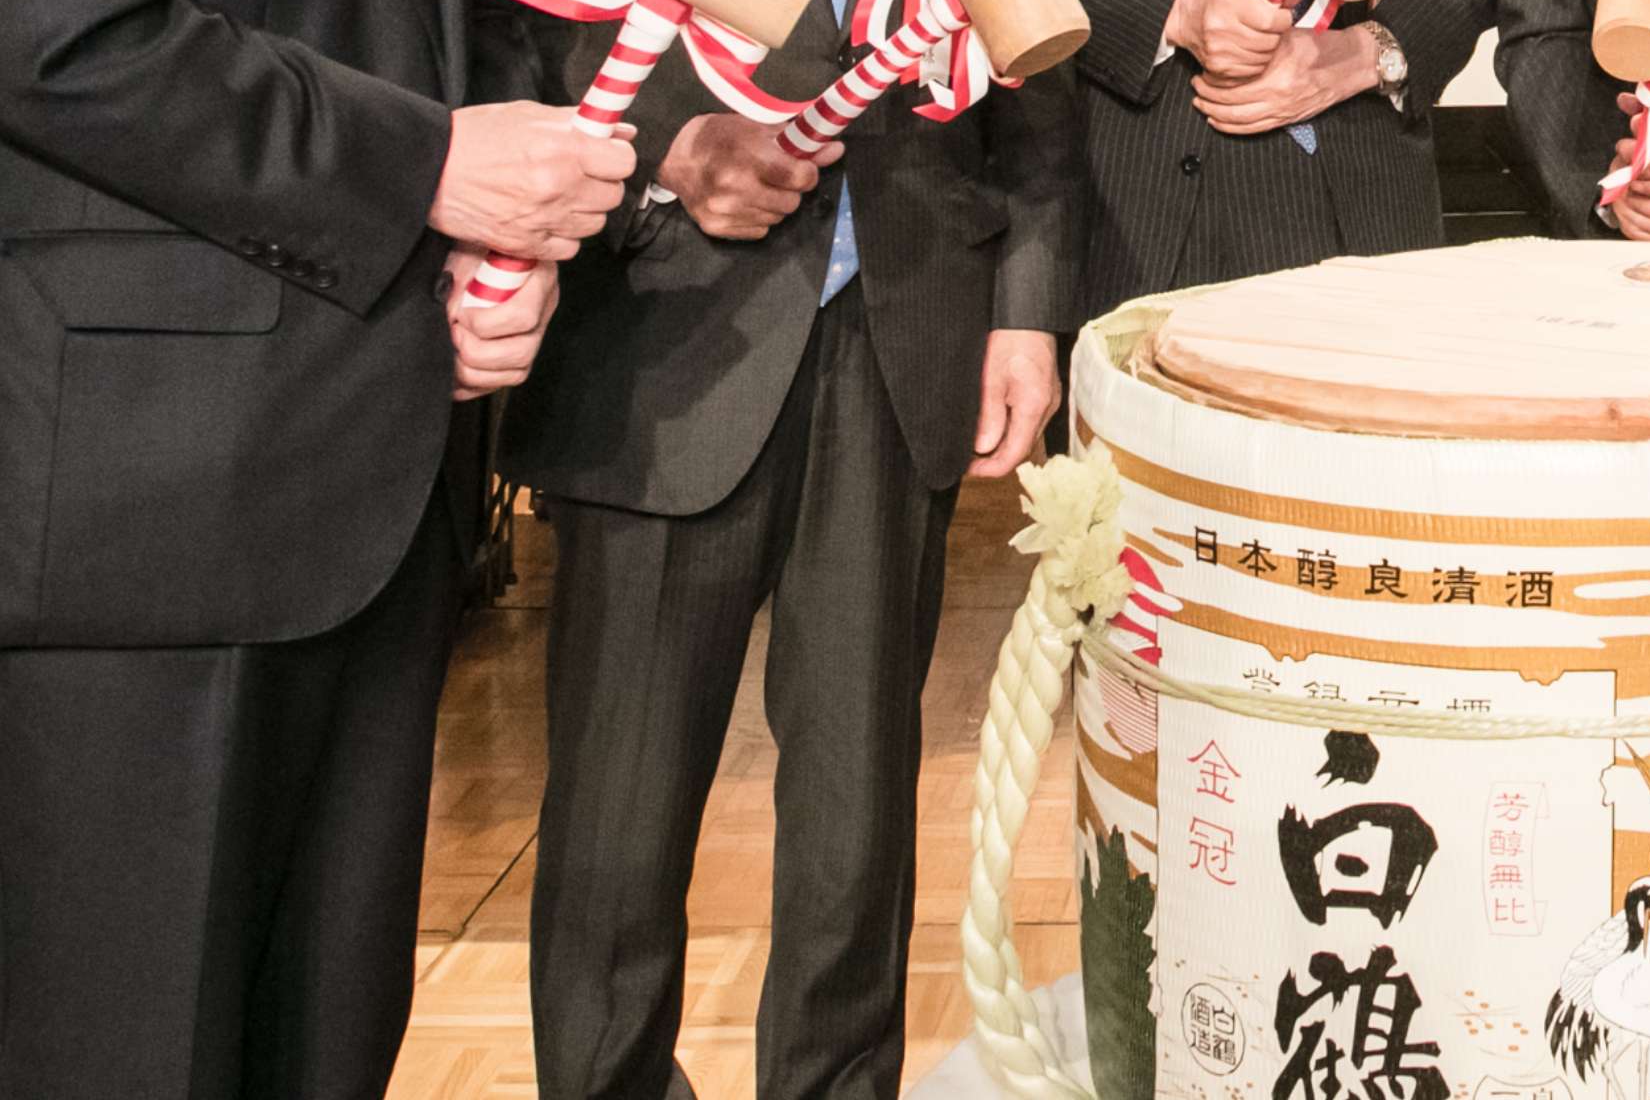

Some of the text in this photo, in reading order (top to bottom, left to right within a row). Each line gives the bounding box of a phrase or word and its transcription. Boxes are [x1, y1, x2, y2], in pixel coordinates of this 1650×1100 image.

[1194, 525, 1555, 609] 日本醇良清酒
[1187, 739, 1242, 887] 金冠
[1489, 792, 1530, 925] 芳醇無比
[1272, 730, 1453, 1100] 白鶴
